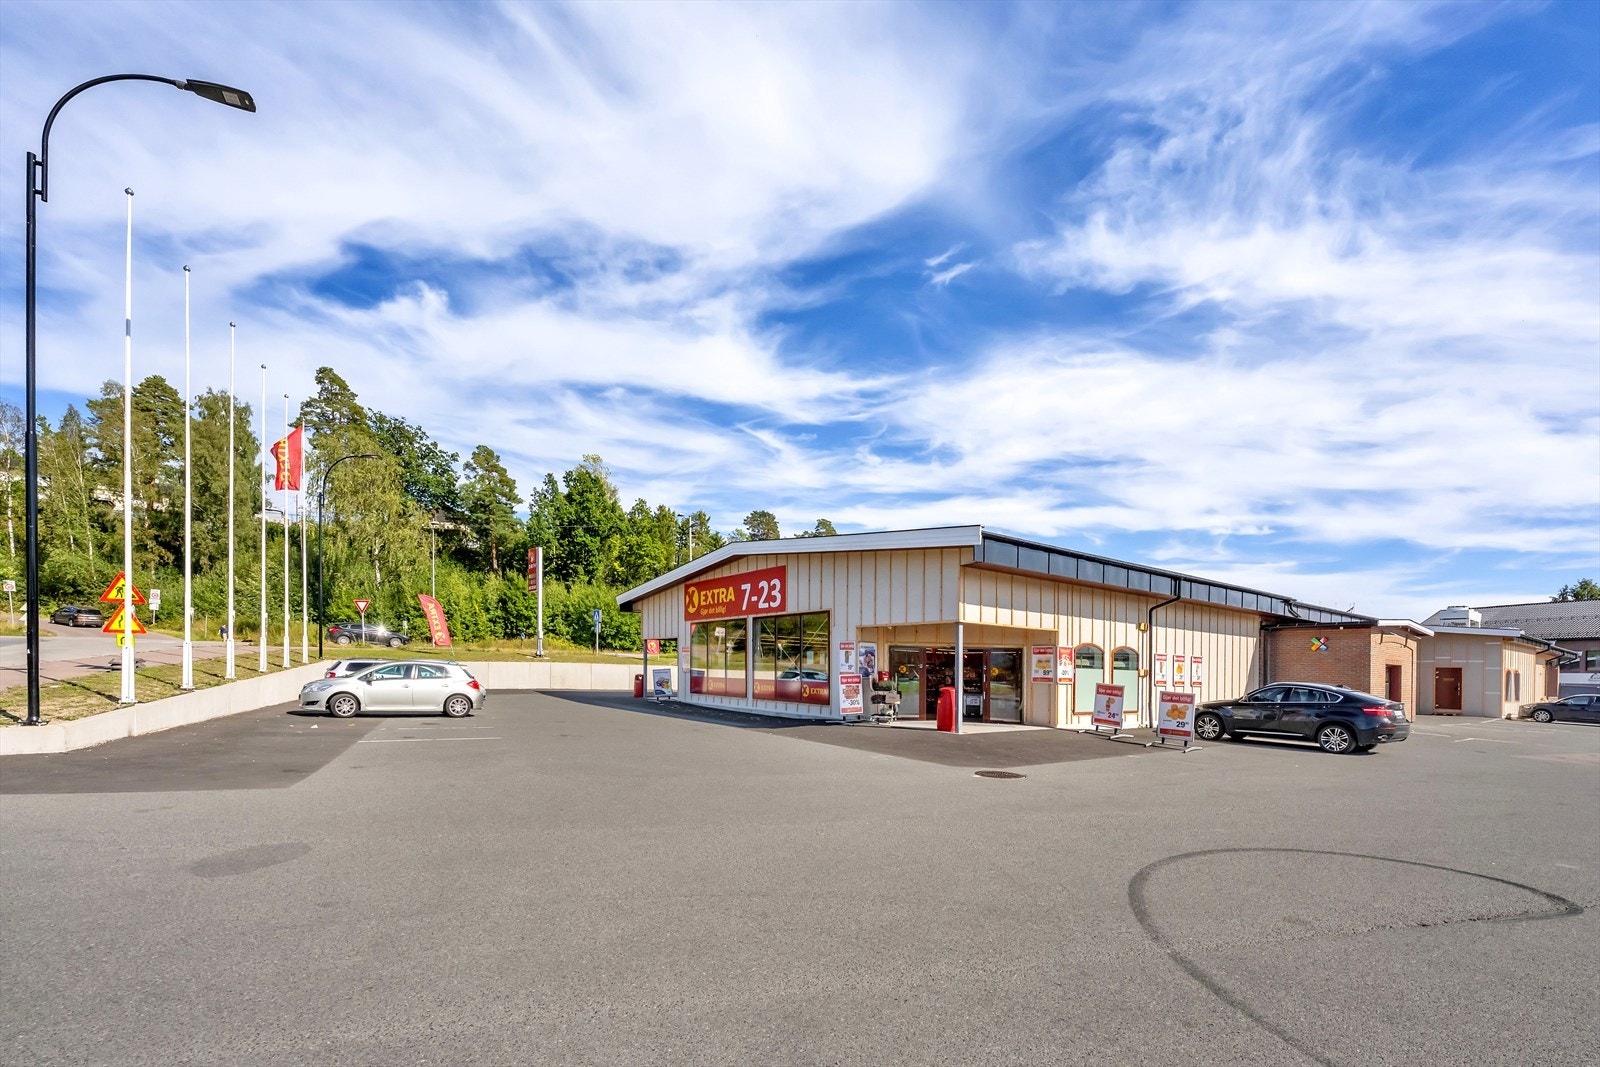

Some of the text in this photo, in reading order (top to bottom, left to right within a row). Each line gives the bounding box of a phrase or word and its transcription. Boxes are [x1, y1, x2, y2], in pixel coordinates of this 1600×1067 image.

[700, 578, 781, 611] EXTRA 7-23
[810, 687, 827, 695] EXTRA
